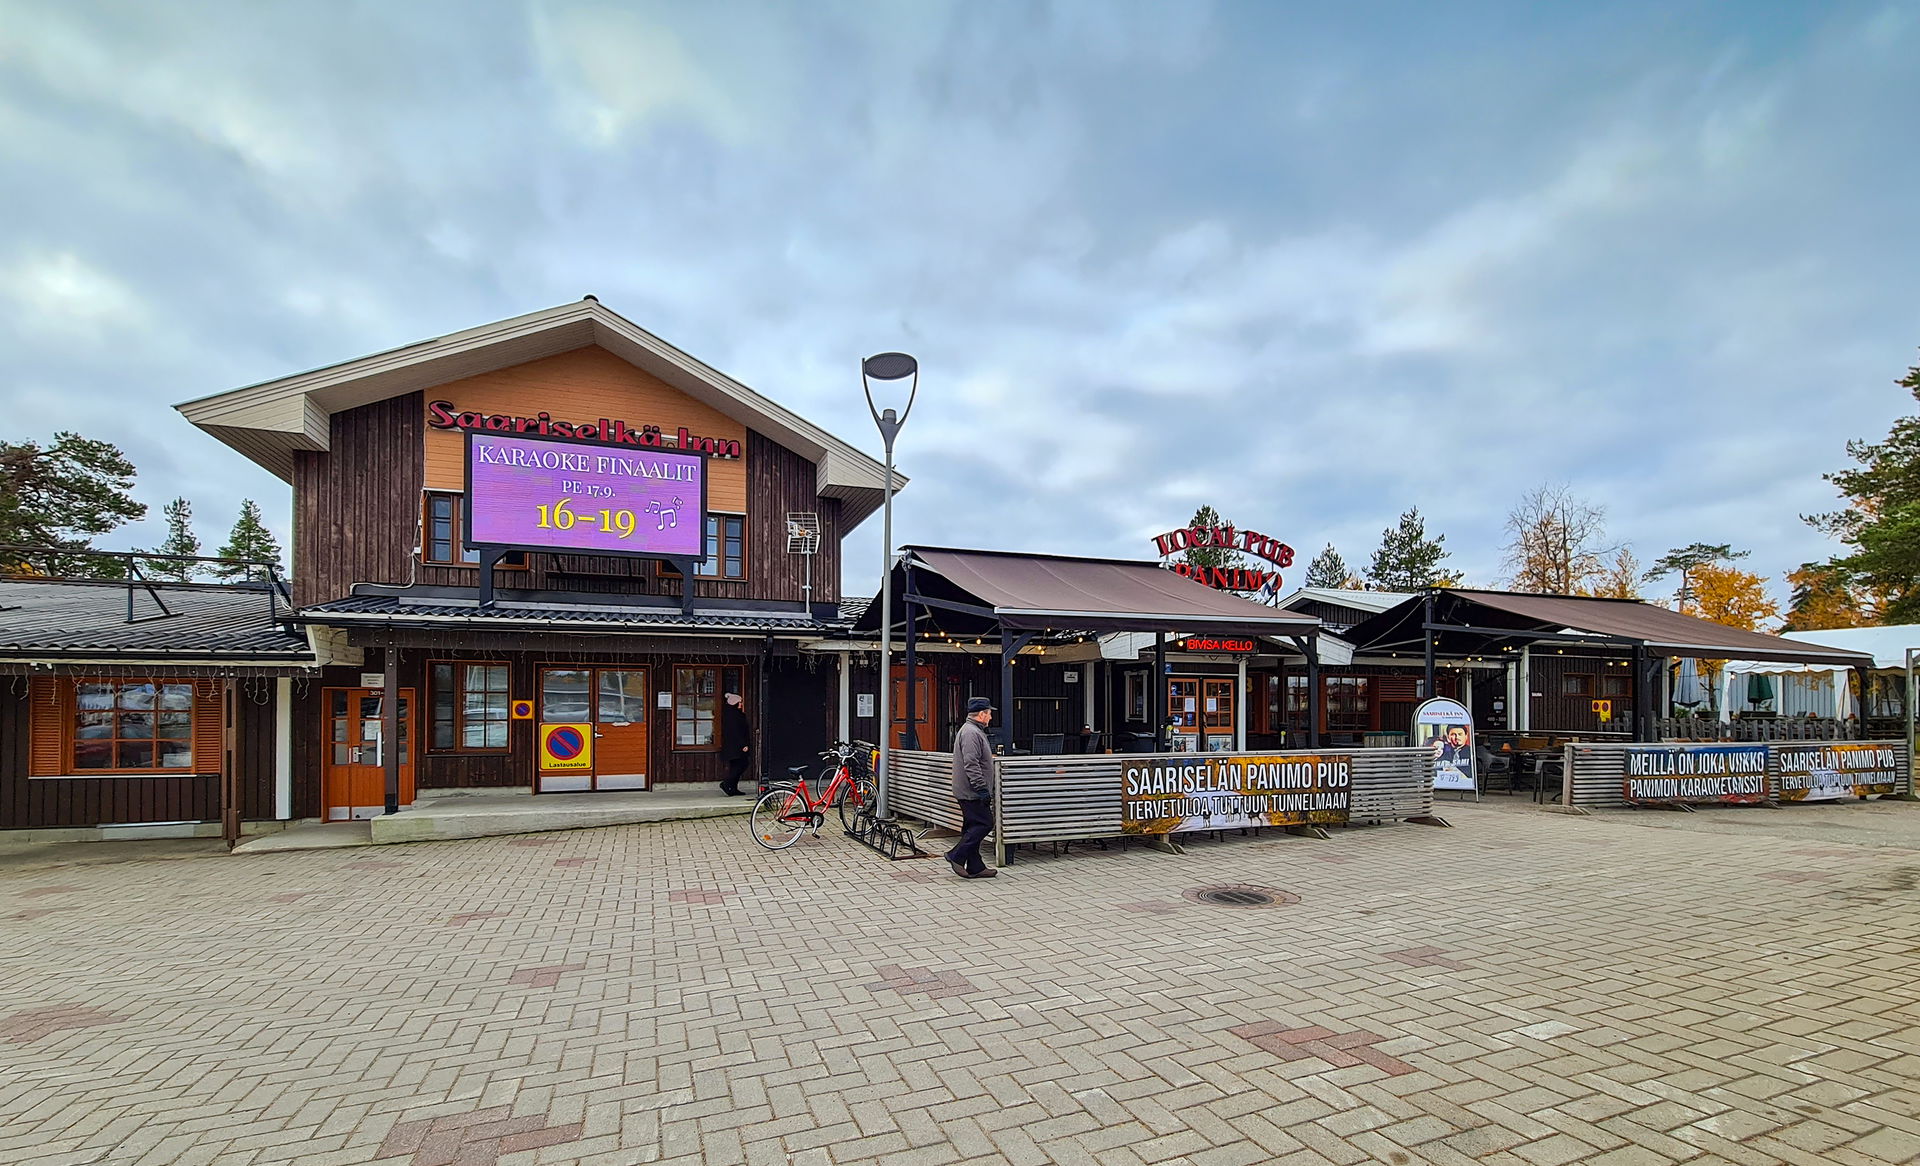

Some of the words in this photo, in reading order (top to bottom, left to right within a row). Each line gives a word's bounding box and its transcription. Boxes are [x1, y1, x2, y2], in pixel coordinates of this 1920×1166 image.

[428, 400, 663, 447] Saariselkä
[677, 426, 741, 458] Inn
[478, 444, 590, 473] KARAOKE
[596, 455, 698, 482] FINAALIT
[562, 479, 583, 494] PE
[586, 484, 617, 499] 17.9.
[1151, 525, 1240, 558] LOCAL
[1244, 530, 1296, 569] PUB
[1174, 562, 1283, 592] PANIMO
[1222, 640, 1253, 651] KELLO
[1630, 749, 1676, 776] MEILLÄ
[1678, 752, 1695, 775] ON
[1697, 752, 1726, 775] JOKA
[1727, 751, 1765, 773] VIIKKO
[1780, 747, 1839, 773] SAARISELÄN
[1841, 750, 1875, 769] PANIMO
[1877, 749, 1896, 768] PUB
[1126, 760, 1242, 797] SAARISELÄN
[1247, 762, 1313, 791] PANIMO
[1317, 761, 1349, 789] PUB
[1630, 778, 1678, 798] PANIMON
[1680, 775, 1764, 797] KARAOKETANSSIT
[1781, 774, 1824, 790] TERVETULOA
[1854, 771, 1896, 786] TUNNELMAAN
[1127, 797, 1211, 821] TERVETULOA
[1212, 794, 1269, 816] TUTTUUN
[1270, 791, 1348, 813] TUNNELMAAN
